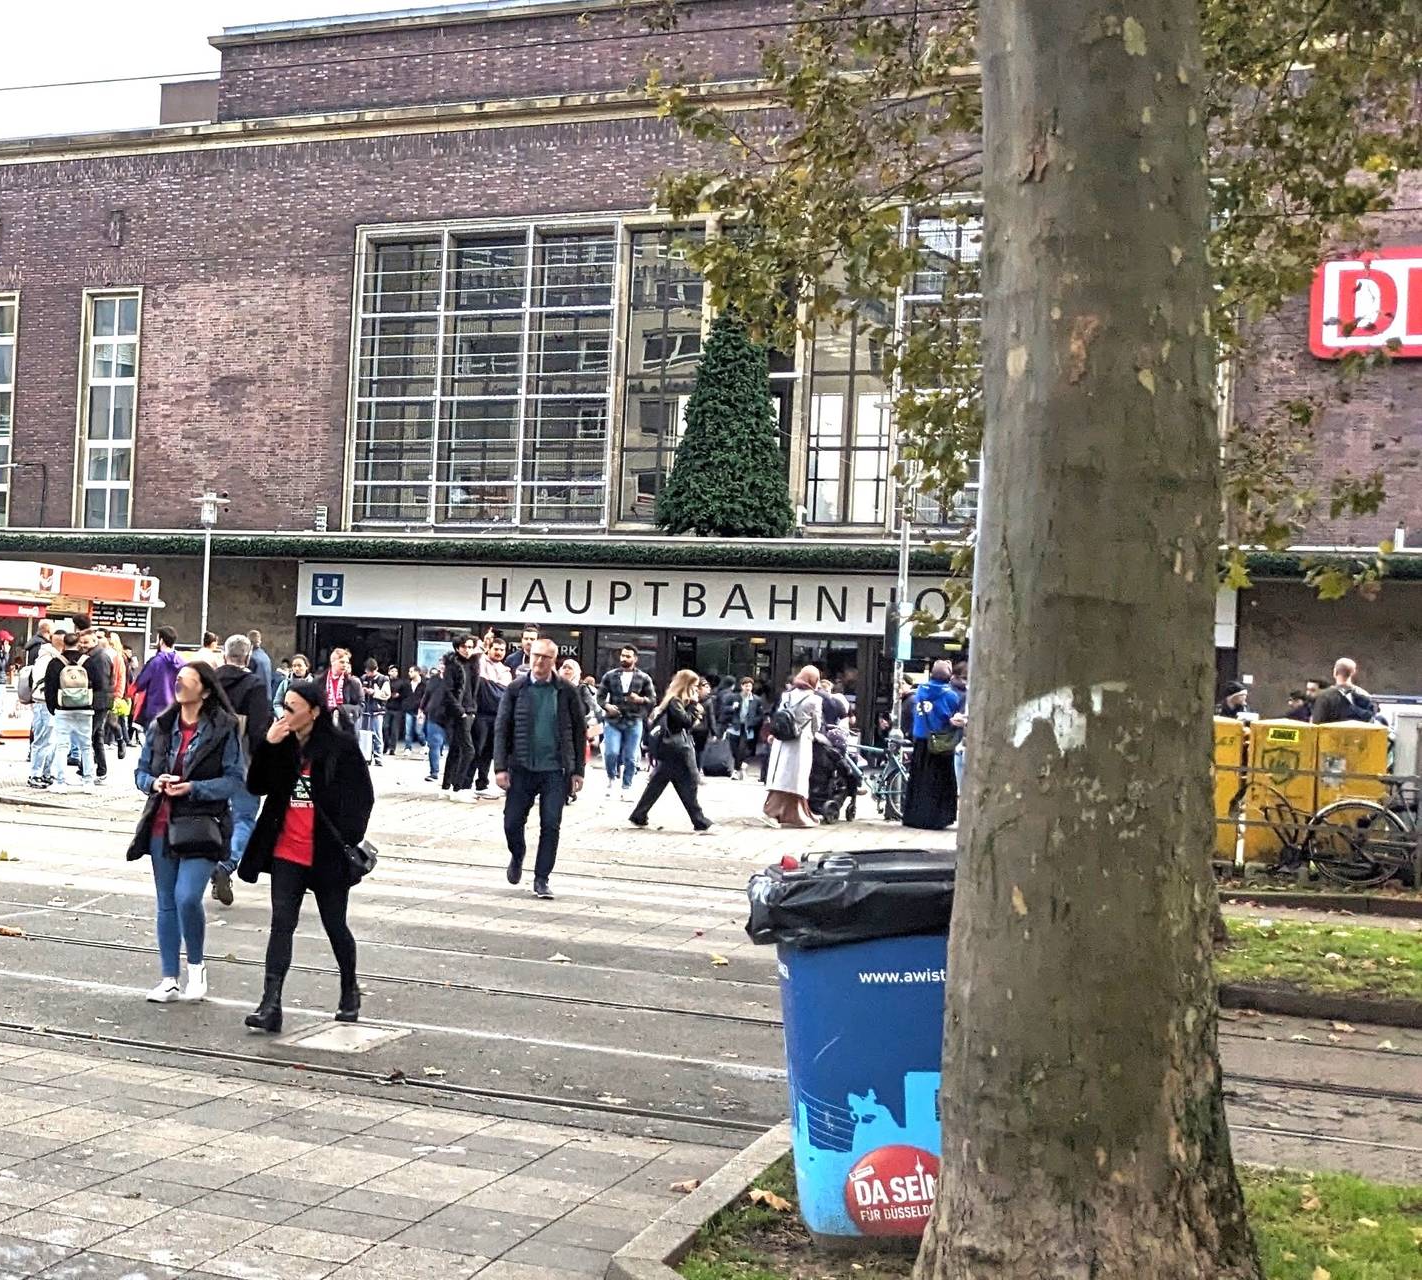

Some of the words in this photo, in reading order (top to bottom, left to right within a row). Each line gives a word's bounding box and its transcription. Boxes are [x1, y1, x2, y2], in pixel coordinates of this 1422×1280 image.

[1337, 267, 1422, 337] D
[854, 1179, 889, 1206] DA
[860, 1206, 881, 1221] FÜR
